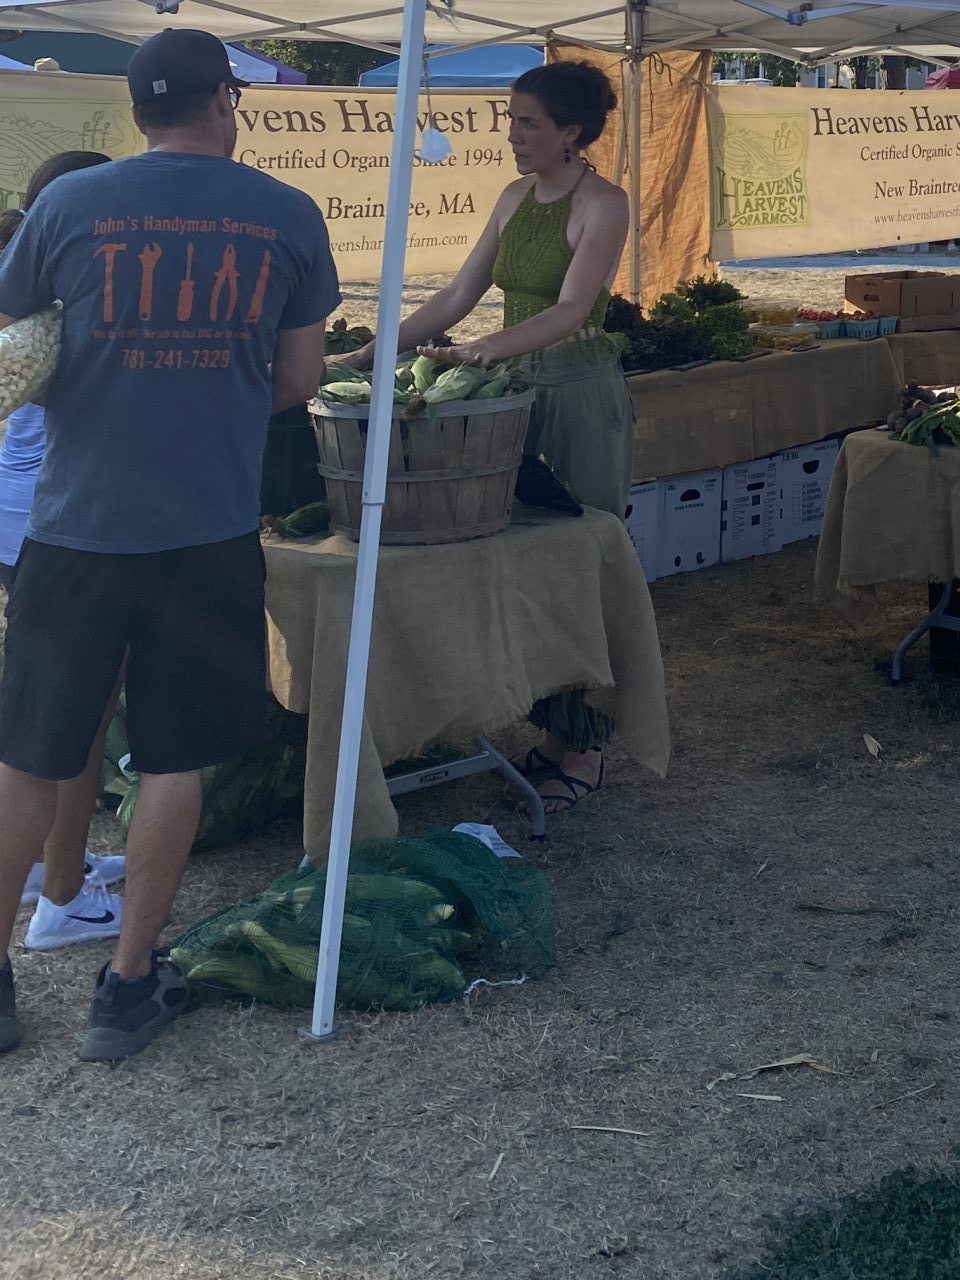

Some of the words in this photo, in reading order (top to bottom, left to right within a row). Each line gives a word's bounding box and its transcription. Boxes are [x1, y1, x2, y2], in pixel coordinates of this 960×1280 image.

[236, 108, 326, 132] vens
[334, 99, 478, 133] Havest
[811, 107, 908, 136] Heavens
[240, 148, 326, 169] Certified
[332, 149, 392, 173] Organ
[463, 148, 504, 167] 1994
[861, 145, 908, 161] Certified
[912, 144, 953, 162] Organic
[874, 181, 904, 199] New
[326, 197, 431, 220] Brainee,
[438, 192, 476, 215] MA
[94, 216, 138, 235] John's
[144, 215, 217, 235] Handyman
[222, 217, 278, 241] Services
[122, 349, 230, 369] 781-241-7329
